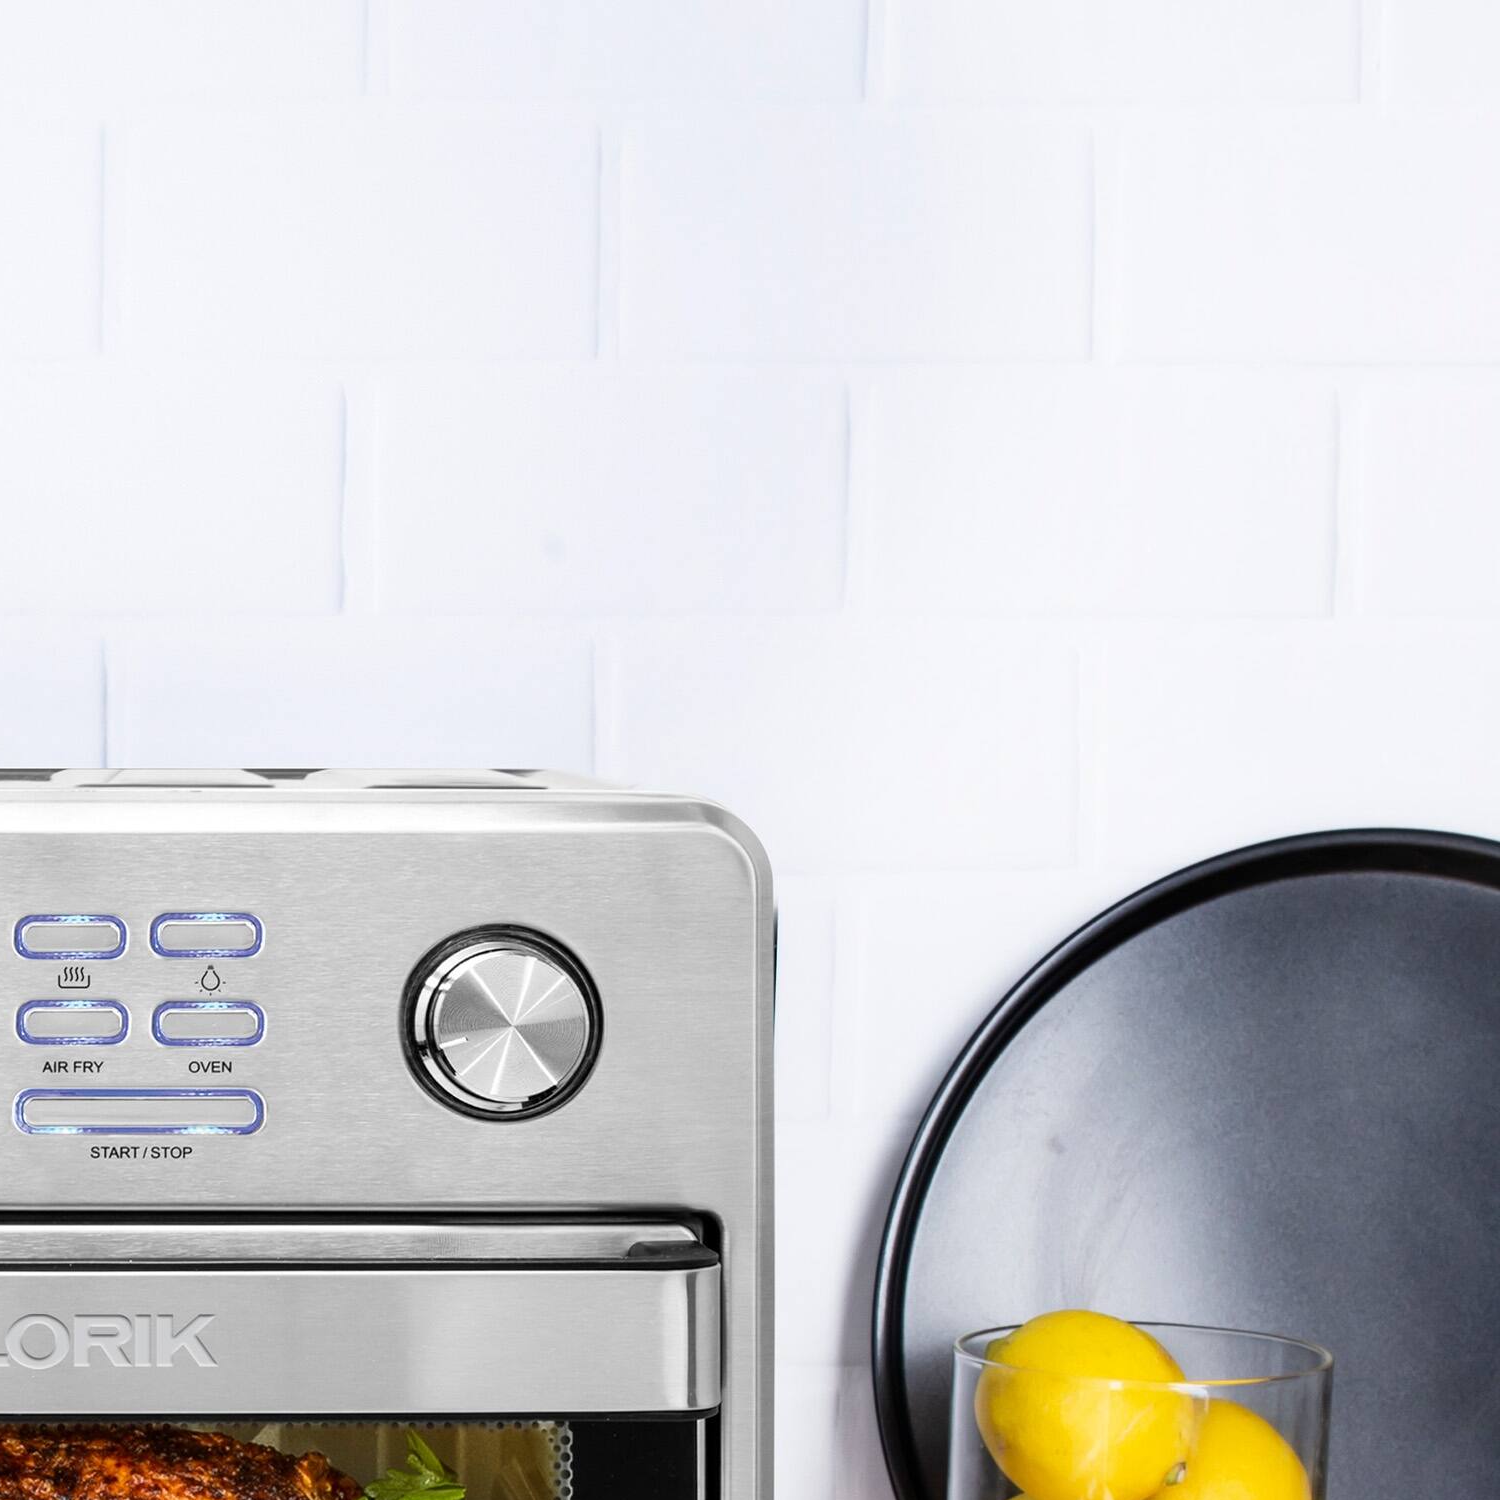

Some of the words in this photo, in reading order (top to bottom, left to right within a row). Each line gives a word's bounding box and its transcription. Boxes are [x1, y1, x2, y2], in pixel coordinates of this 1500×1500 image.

[42, 1061, 68, 1073] AIR
[73, 1061, 104, 1073] FRY
[188, 1061, 233, 1074] OVEN
[90, 1146, 140, 1159] START
[150, 1146, 193, 1159] STOP
